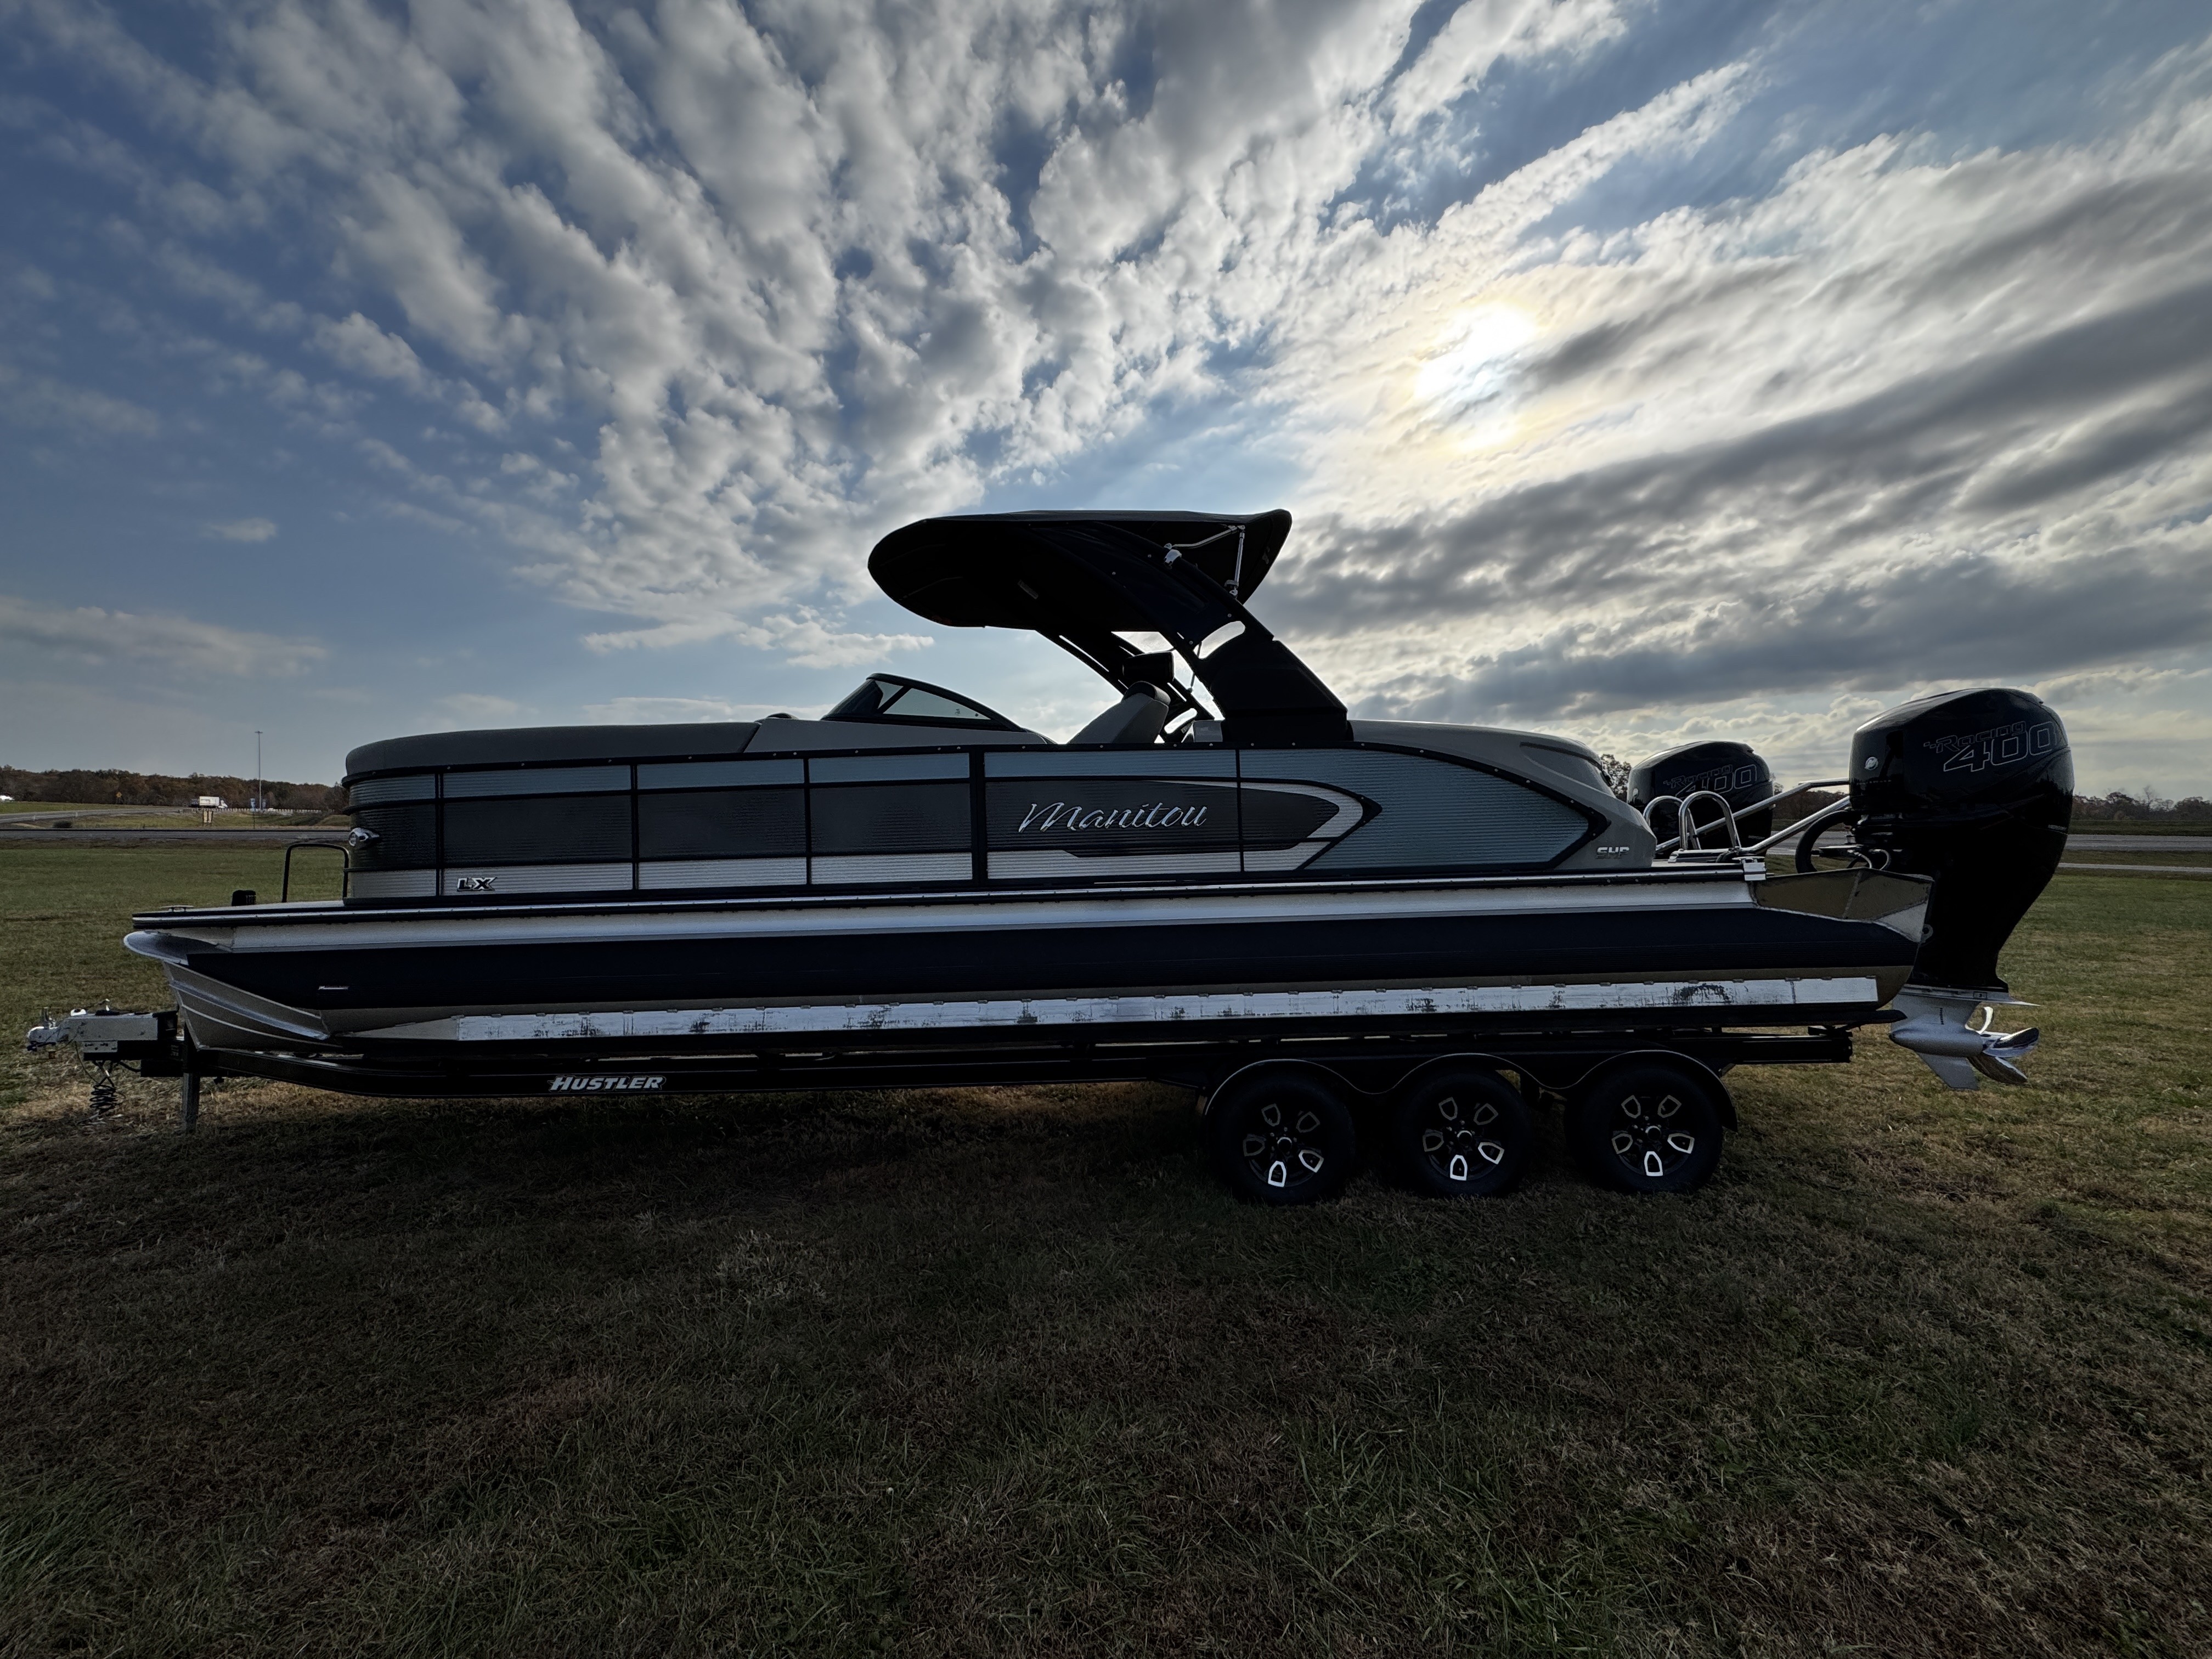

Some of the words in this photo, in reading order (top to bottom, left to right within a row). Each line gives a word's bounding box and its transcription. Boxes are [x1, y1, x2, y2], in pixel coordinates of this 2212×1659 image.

[1936, 720, 2027, 754] Racing
[1943, 721, 2057, 772] 400
[1675, 764, 1758, 799] 400
[1018, 802, 1207, 833] Manitou
[457, 877, 497, 891] LX
[549, 1075, 666, 1091] HUSTLER
